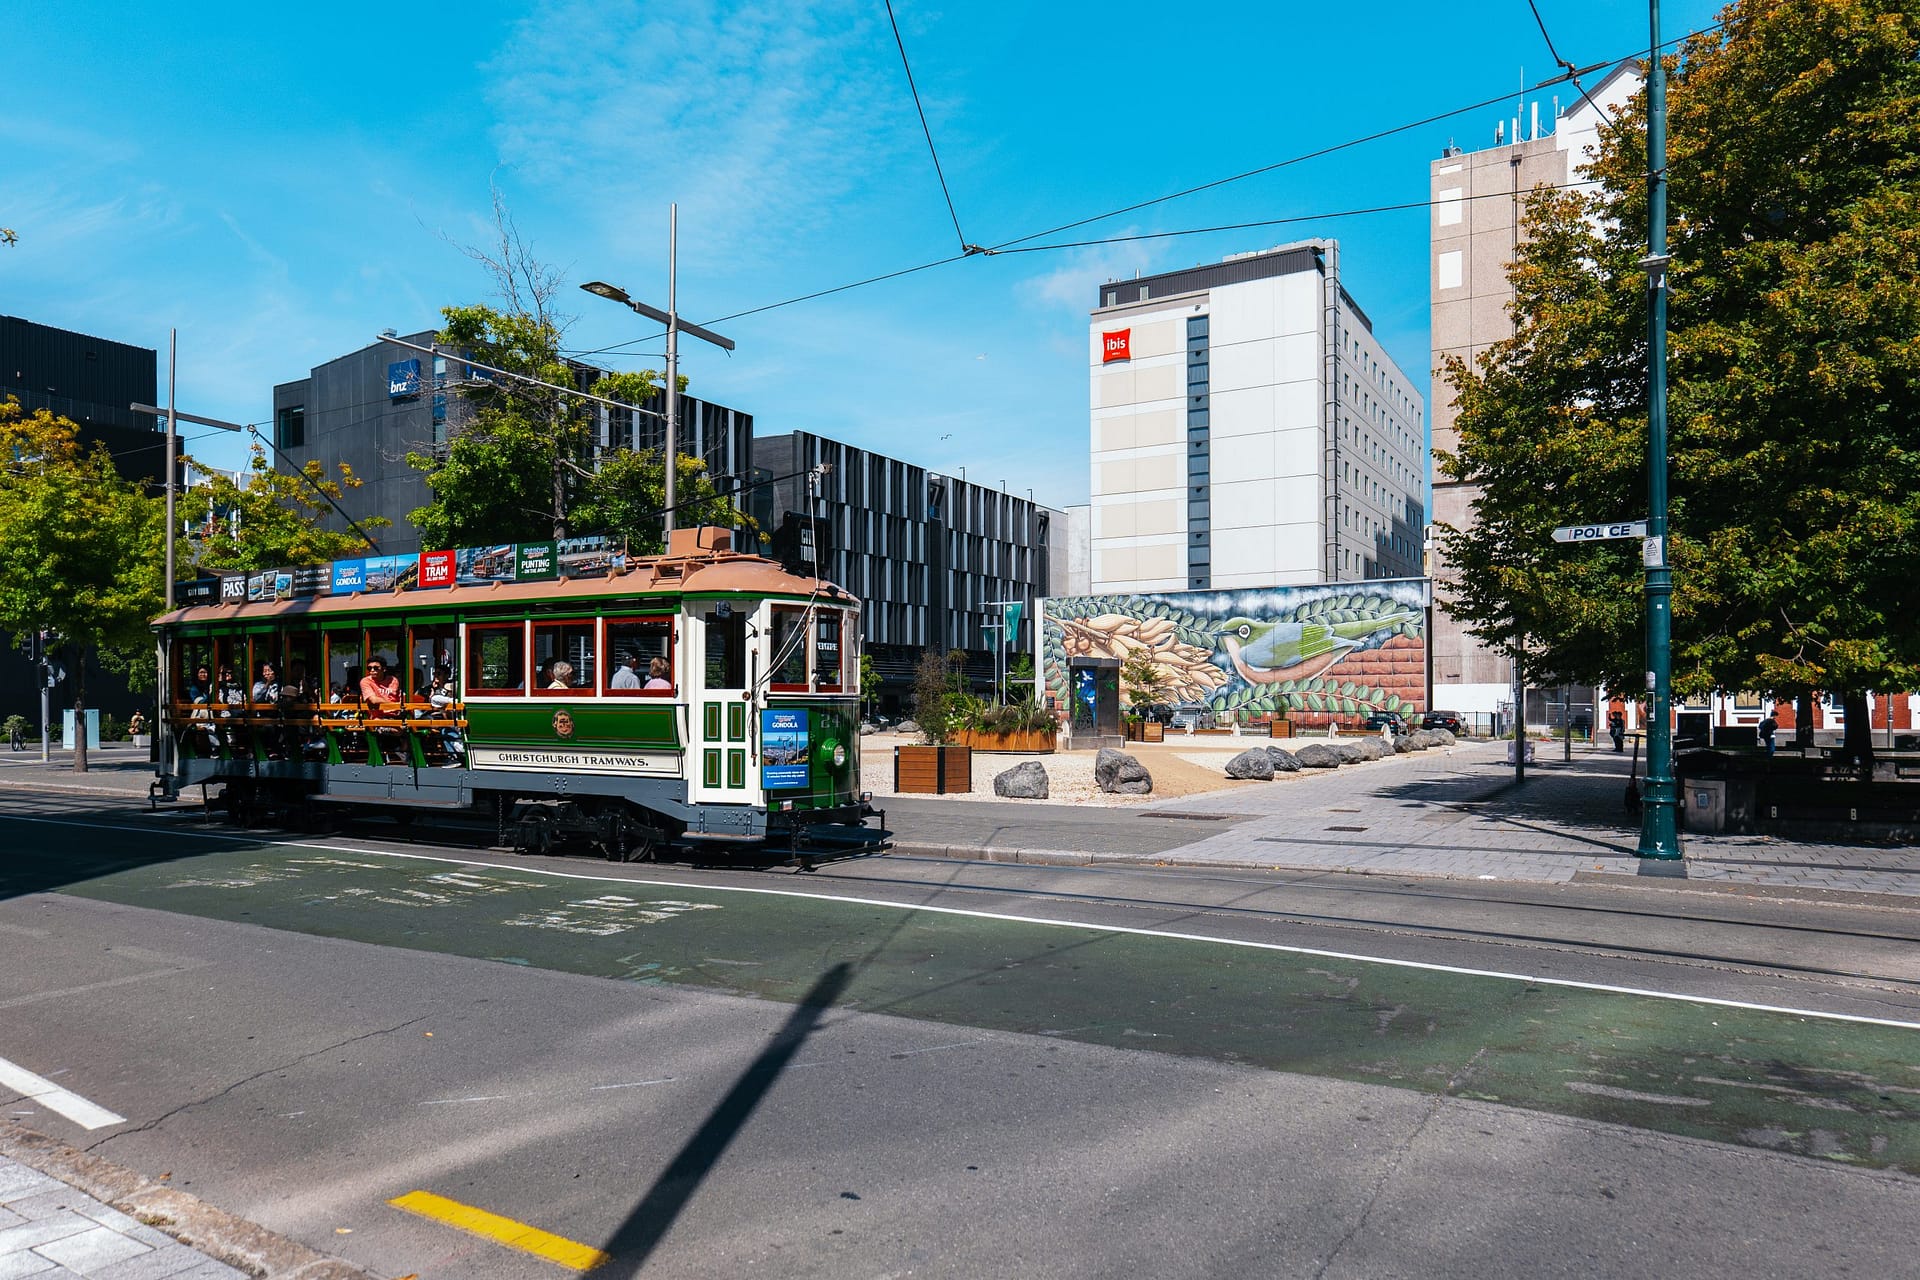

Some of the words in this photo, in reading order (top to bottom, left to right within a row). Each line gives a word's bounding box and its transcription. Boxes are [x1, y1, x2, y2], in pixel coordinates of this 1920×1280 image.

[1106, 337, 1126, 351] ibis
[390, 380, 407, 393] bnz
[1573, 525, 1631, 539] POLCE
[521, 558, 550, 569] PUNTING
[425, 565, 448, 577] TRAM
[336, 576, 361, 586] GONDOLA
[222, 581, 245, 598] PASS
[772, 721, 798, 729] GONDOLA
[582, 755, 649, 767] TRAMWAYS.
